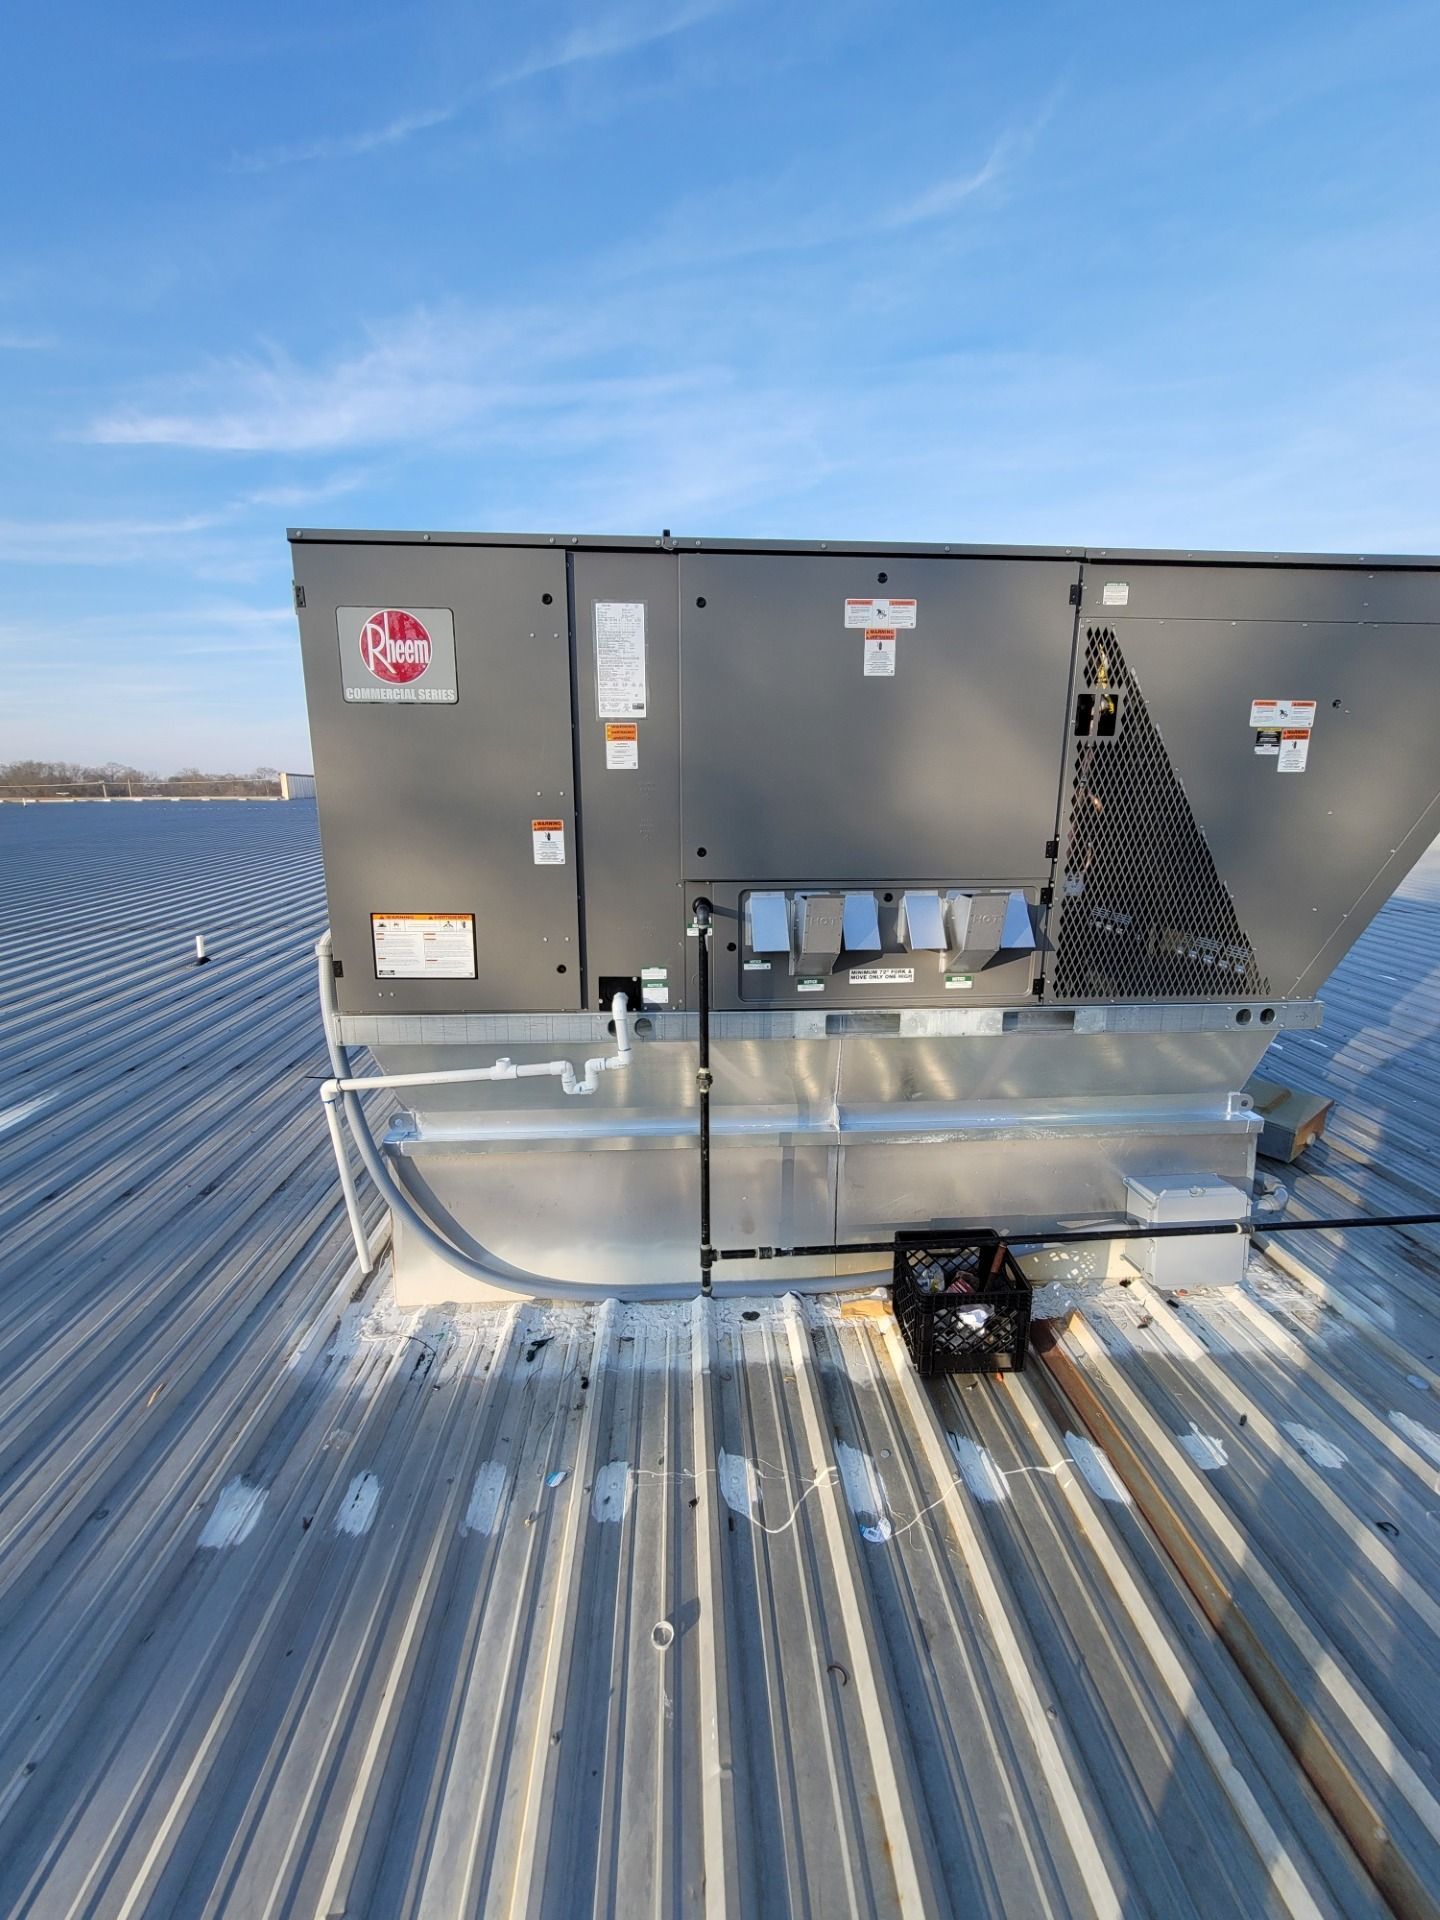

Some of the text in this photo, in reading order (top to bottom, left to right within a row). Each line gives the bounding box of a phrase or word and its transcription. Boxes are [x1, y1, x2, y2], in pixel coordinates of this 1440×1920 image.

[366, 612, 430, 674] Rheem
[345, 687, 455, 701] COMMERCIAL SERIES
[971, 911, 1000, 924] HOT
